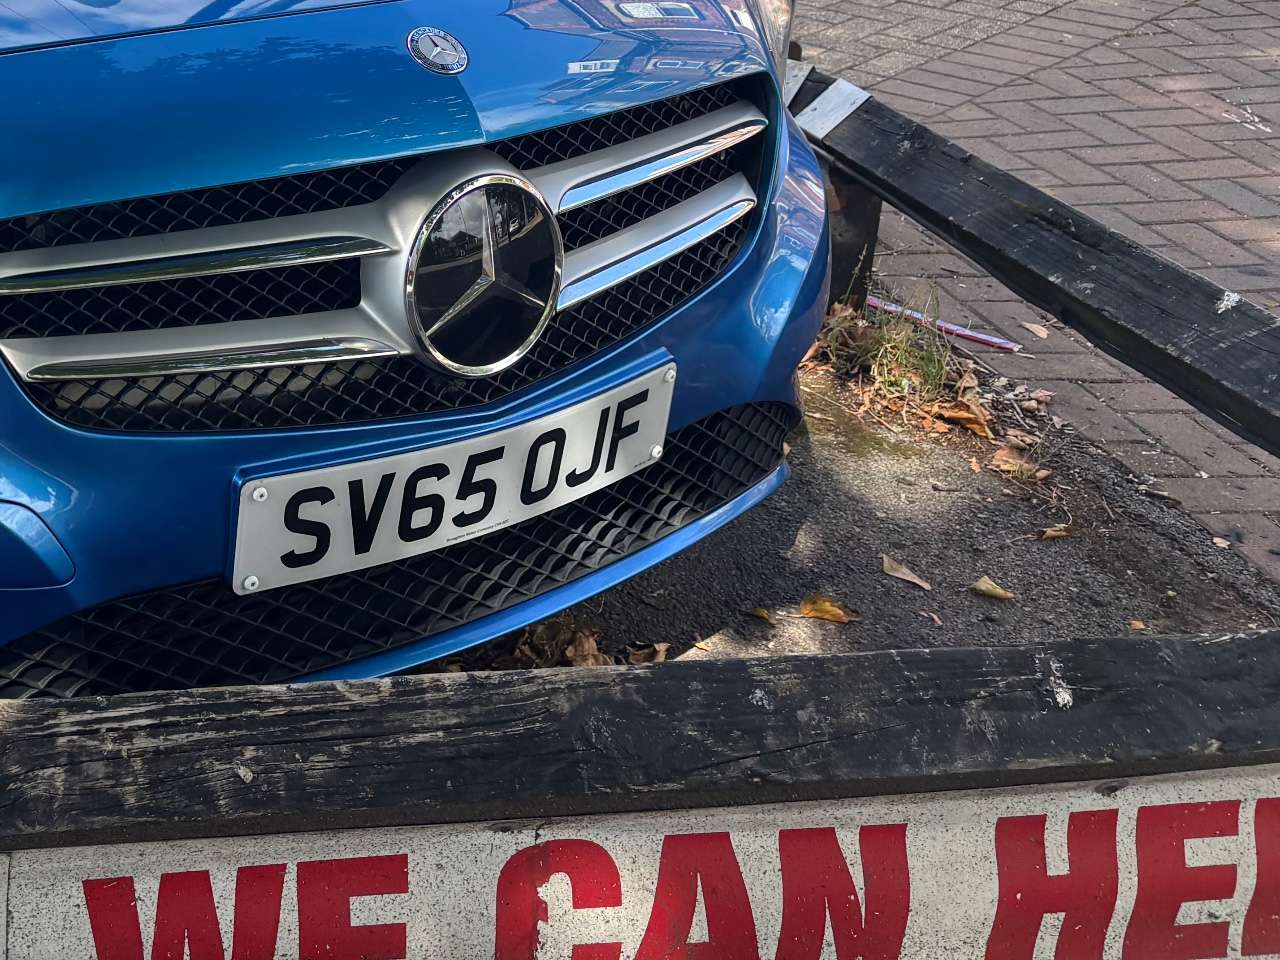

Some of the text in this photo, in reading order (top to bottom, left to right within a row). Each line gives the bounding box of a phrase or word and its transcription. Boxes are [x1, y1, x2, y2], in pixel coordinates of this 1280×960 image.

[279, 388, 650, 569] SV65 OJF
[82, 853, 409, 960] WE
[494, 823, 912, 960] CAN
